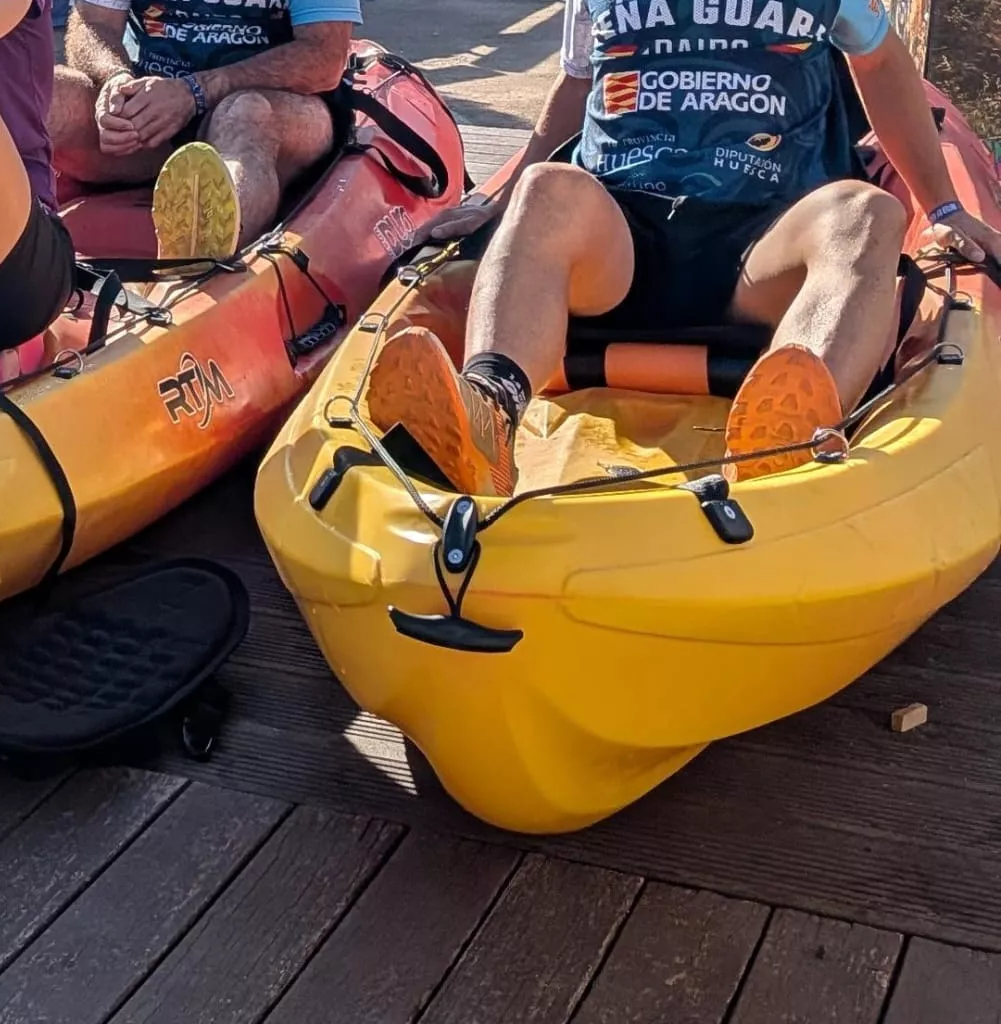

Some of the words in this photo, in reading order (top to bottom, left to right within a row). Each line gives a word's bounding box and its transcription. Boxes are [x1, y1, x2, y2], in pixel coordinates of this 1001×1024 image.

[641, 70, 772, 91] GOBIERNO
[639, 92, 672, 111] DE
[680, 92, 786, 116] ARAGON
